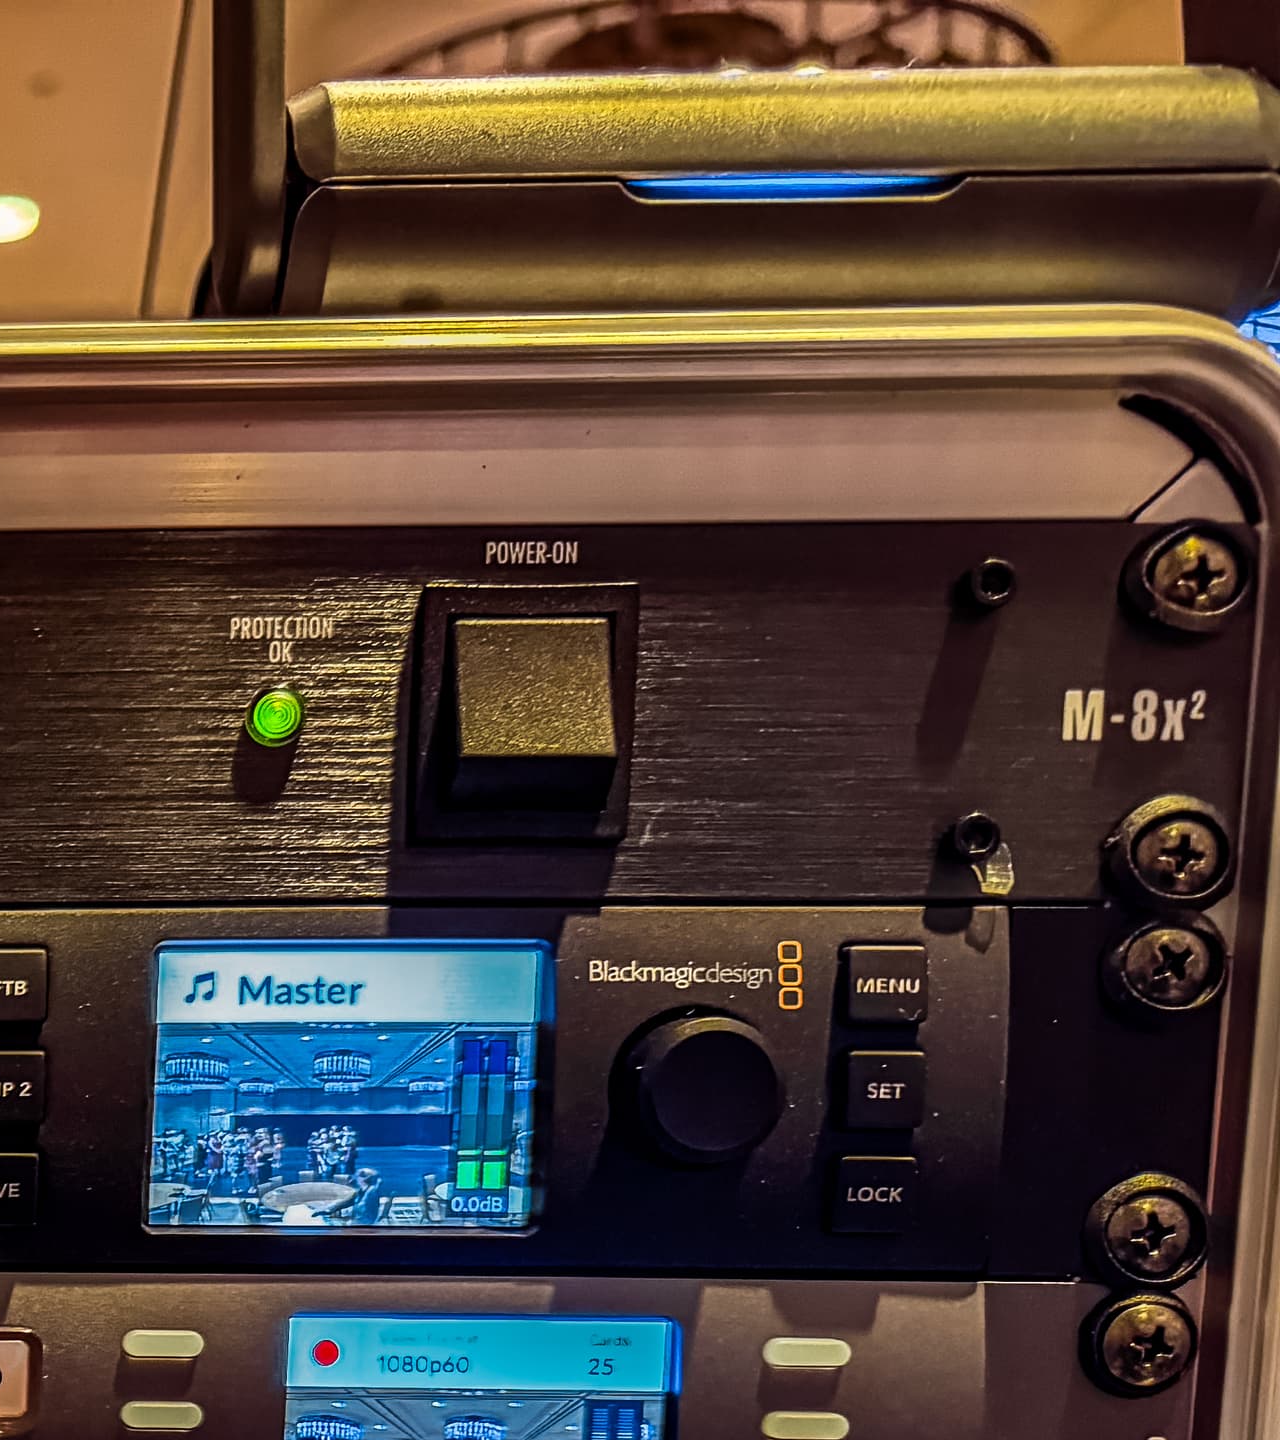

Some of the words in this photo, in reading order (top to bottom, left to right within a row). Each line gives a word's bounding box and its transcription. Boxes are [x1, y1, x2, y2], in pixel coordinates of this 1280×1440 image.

[486, 542, 577, 564] POWER-ON
[230, 615, 334, 640] PROTECTION
[269, 641, 294, 667] OK
[239, 976, 363, 1005] Master
[856, 977, 920, 994] MENU
[19, 1081, 32, 1097] 2
[867, 1082, 905, 1099] SET
[847, 1186, 903, 1203] LOCK
[451, 1195, 507, 1213] 0.0dB
[380, 1356, 469, 1373] 1080p60
[588, 1358, 613, 1375] 25
